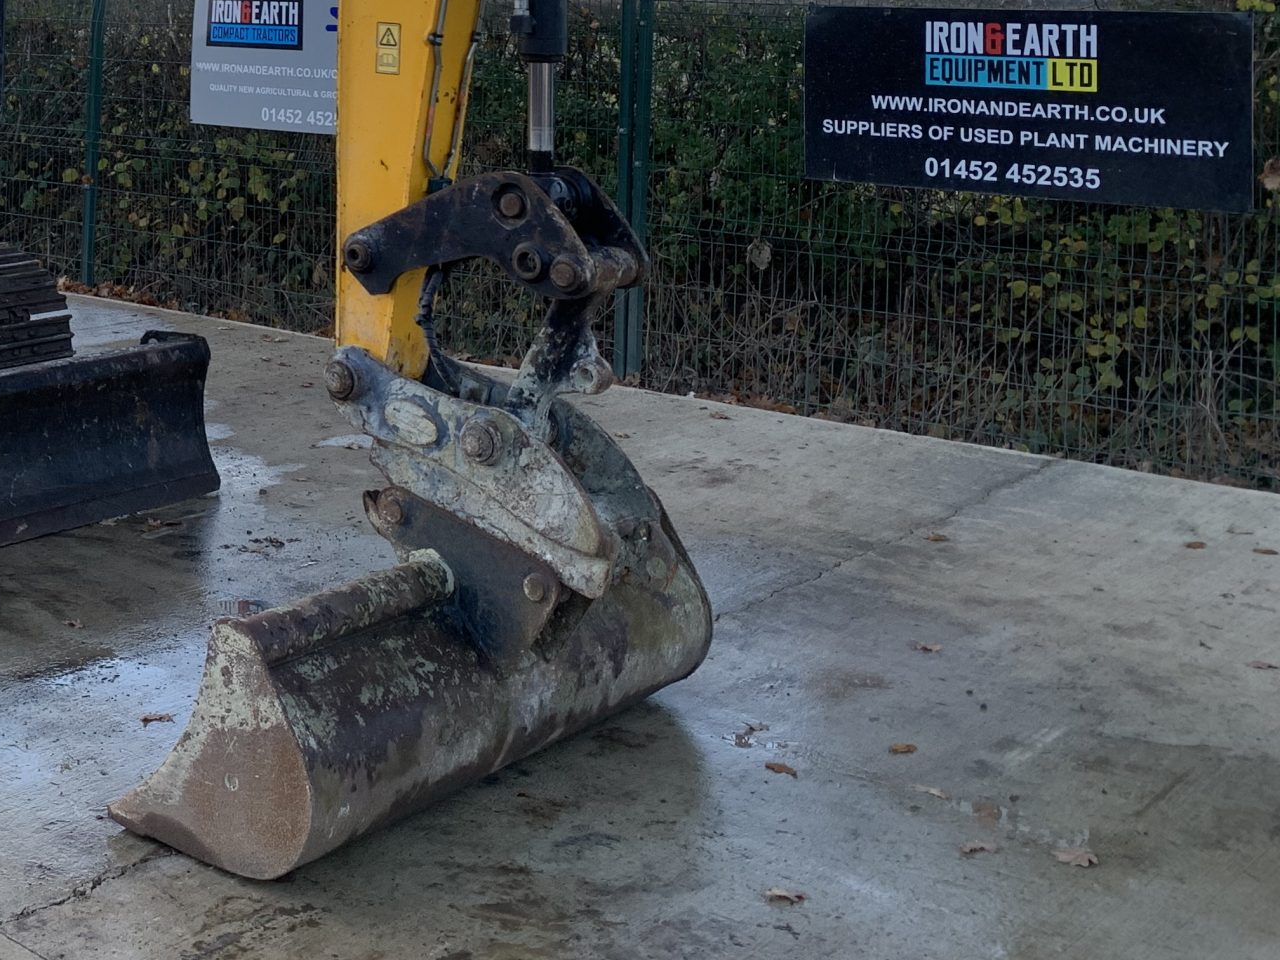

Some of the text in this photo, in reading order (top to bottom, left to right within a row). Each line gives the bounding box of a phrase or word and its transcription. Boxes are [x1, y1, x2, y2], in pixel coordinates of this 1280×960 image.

[212, 26, 296, 42] COMPACT TRACTORS
[930, 57, 1093, 88] EQUIPMENT LTD
[209, 83, 237, 93] QUALITY
[239, 85, 254, 94] NEW
[255, 87, 311, 98] AGRICULTURAL
[261, 107, 302, 124] 01452
[871, 95, 1166, 124] WWW.IRONANDEARTH.CO.UK
[822, 119, 1230, 158] SUPPLIERS OF USED PLANT MACHINERY
[924, 157, 1101, 189] 01452 452535
